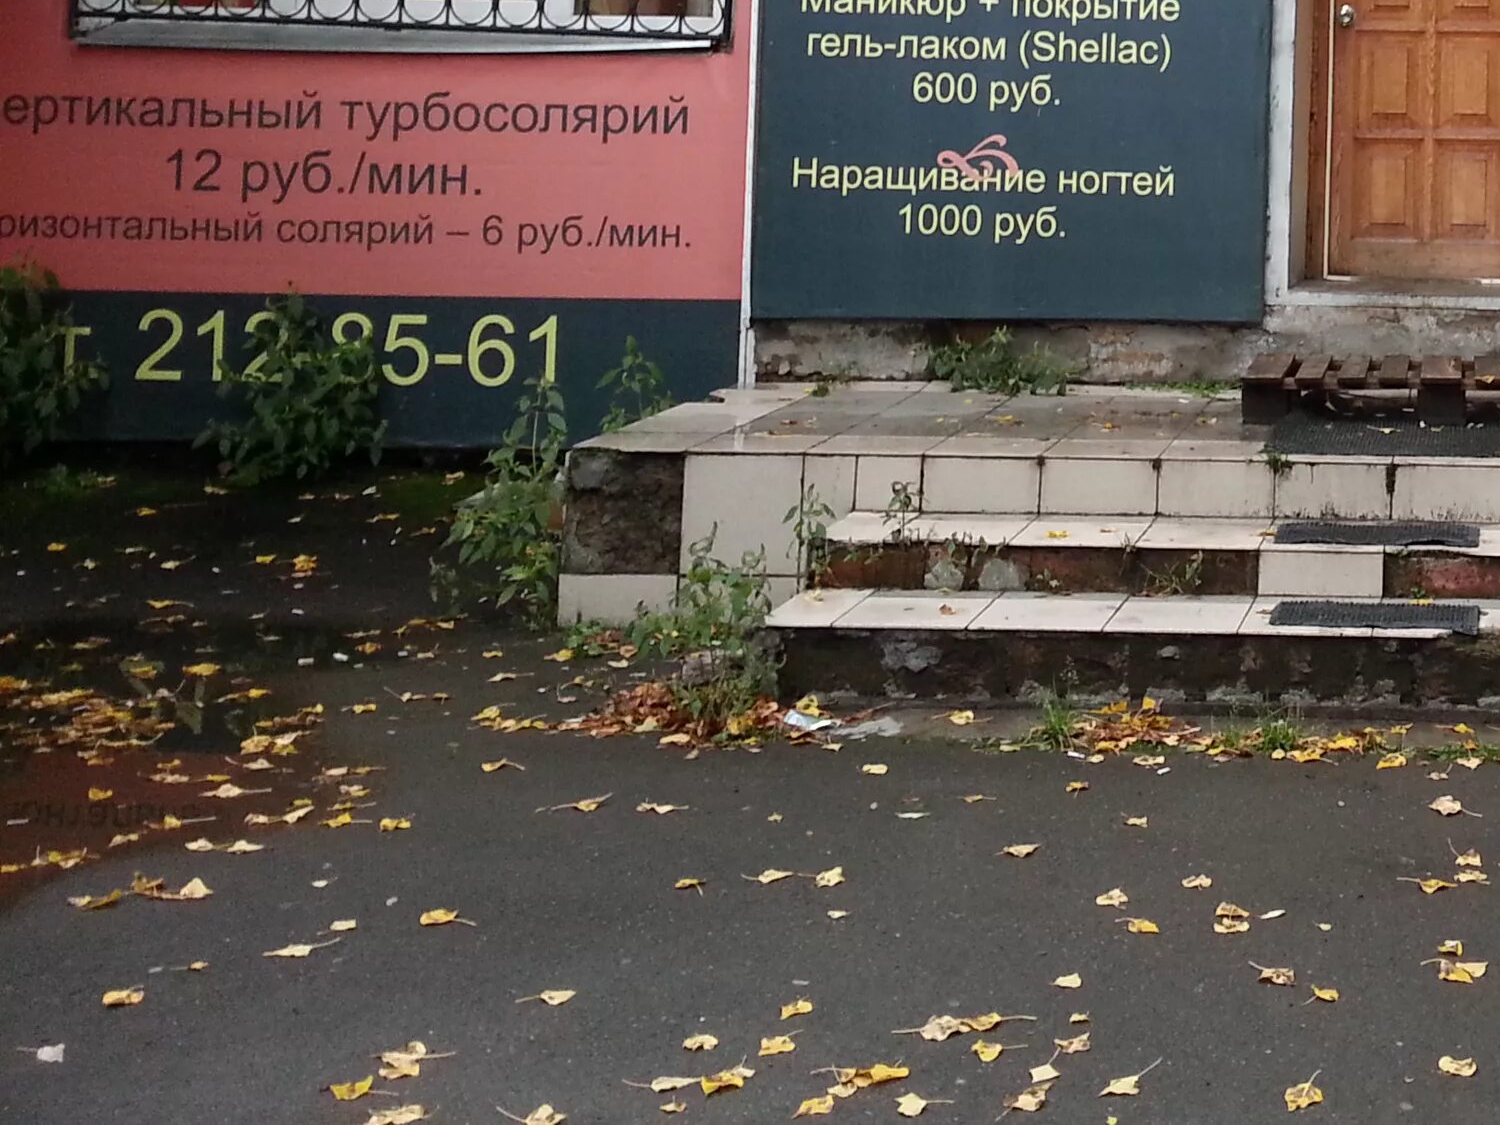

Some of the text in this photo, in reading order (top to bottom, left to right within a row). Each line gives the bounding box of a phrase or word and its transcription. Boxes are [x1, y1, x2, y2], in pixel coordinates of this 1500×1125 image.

[807, 29, 1171, 73] гель-лаком (Shellac)
[913, 71, 1060, 113] 600 руб.
[341, 92, 689, 143] турбосолярий
[166, 148, 481, 205] 12 руб./мин.
[792, 157, 1175, 196] Наращивание ногтей
[276, 214, 433, 252] солярий
[482, 214, 503, 246] 6
[517, 215, 691, 255] руб./мин.
[898, 203, 1066, 245] 1000 руб.
